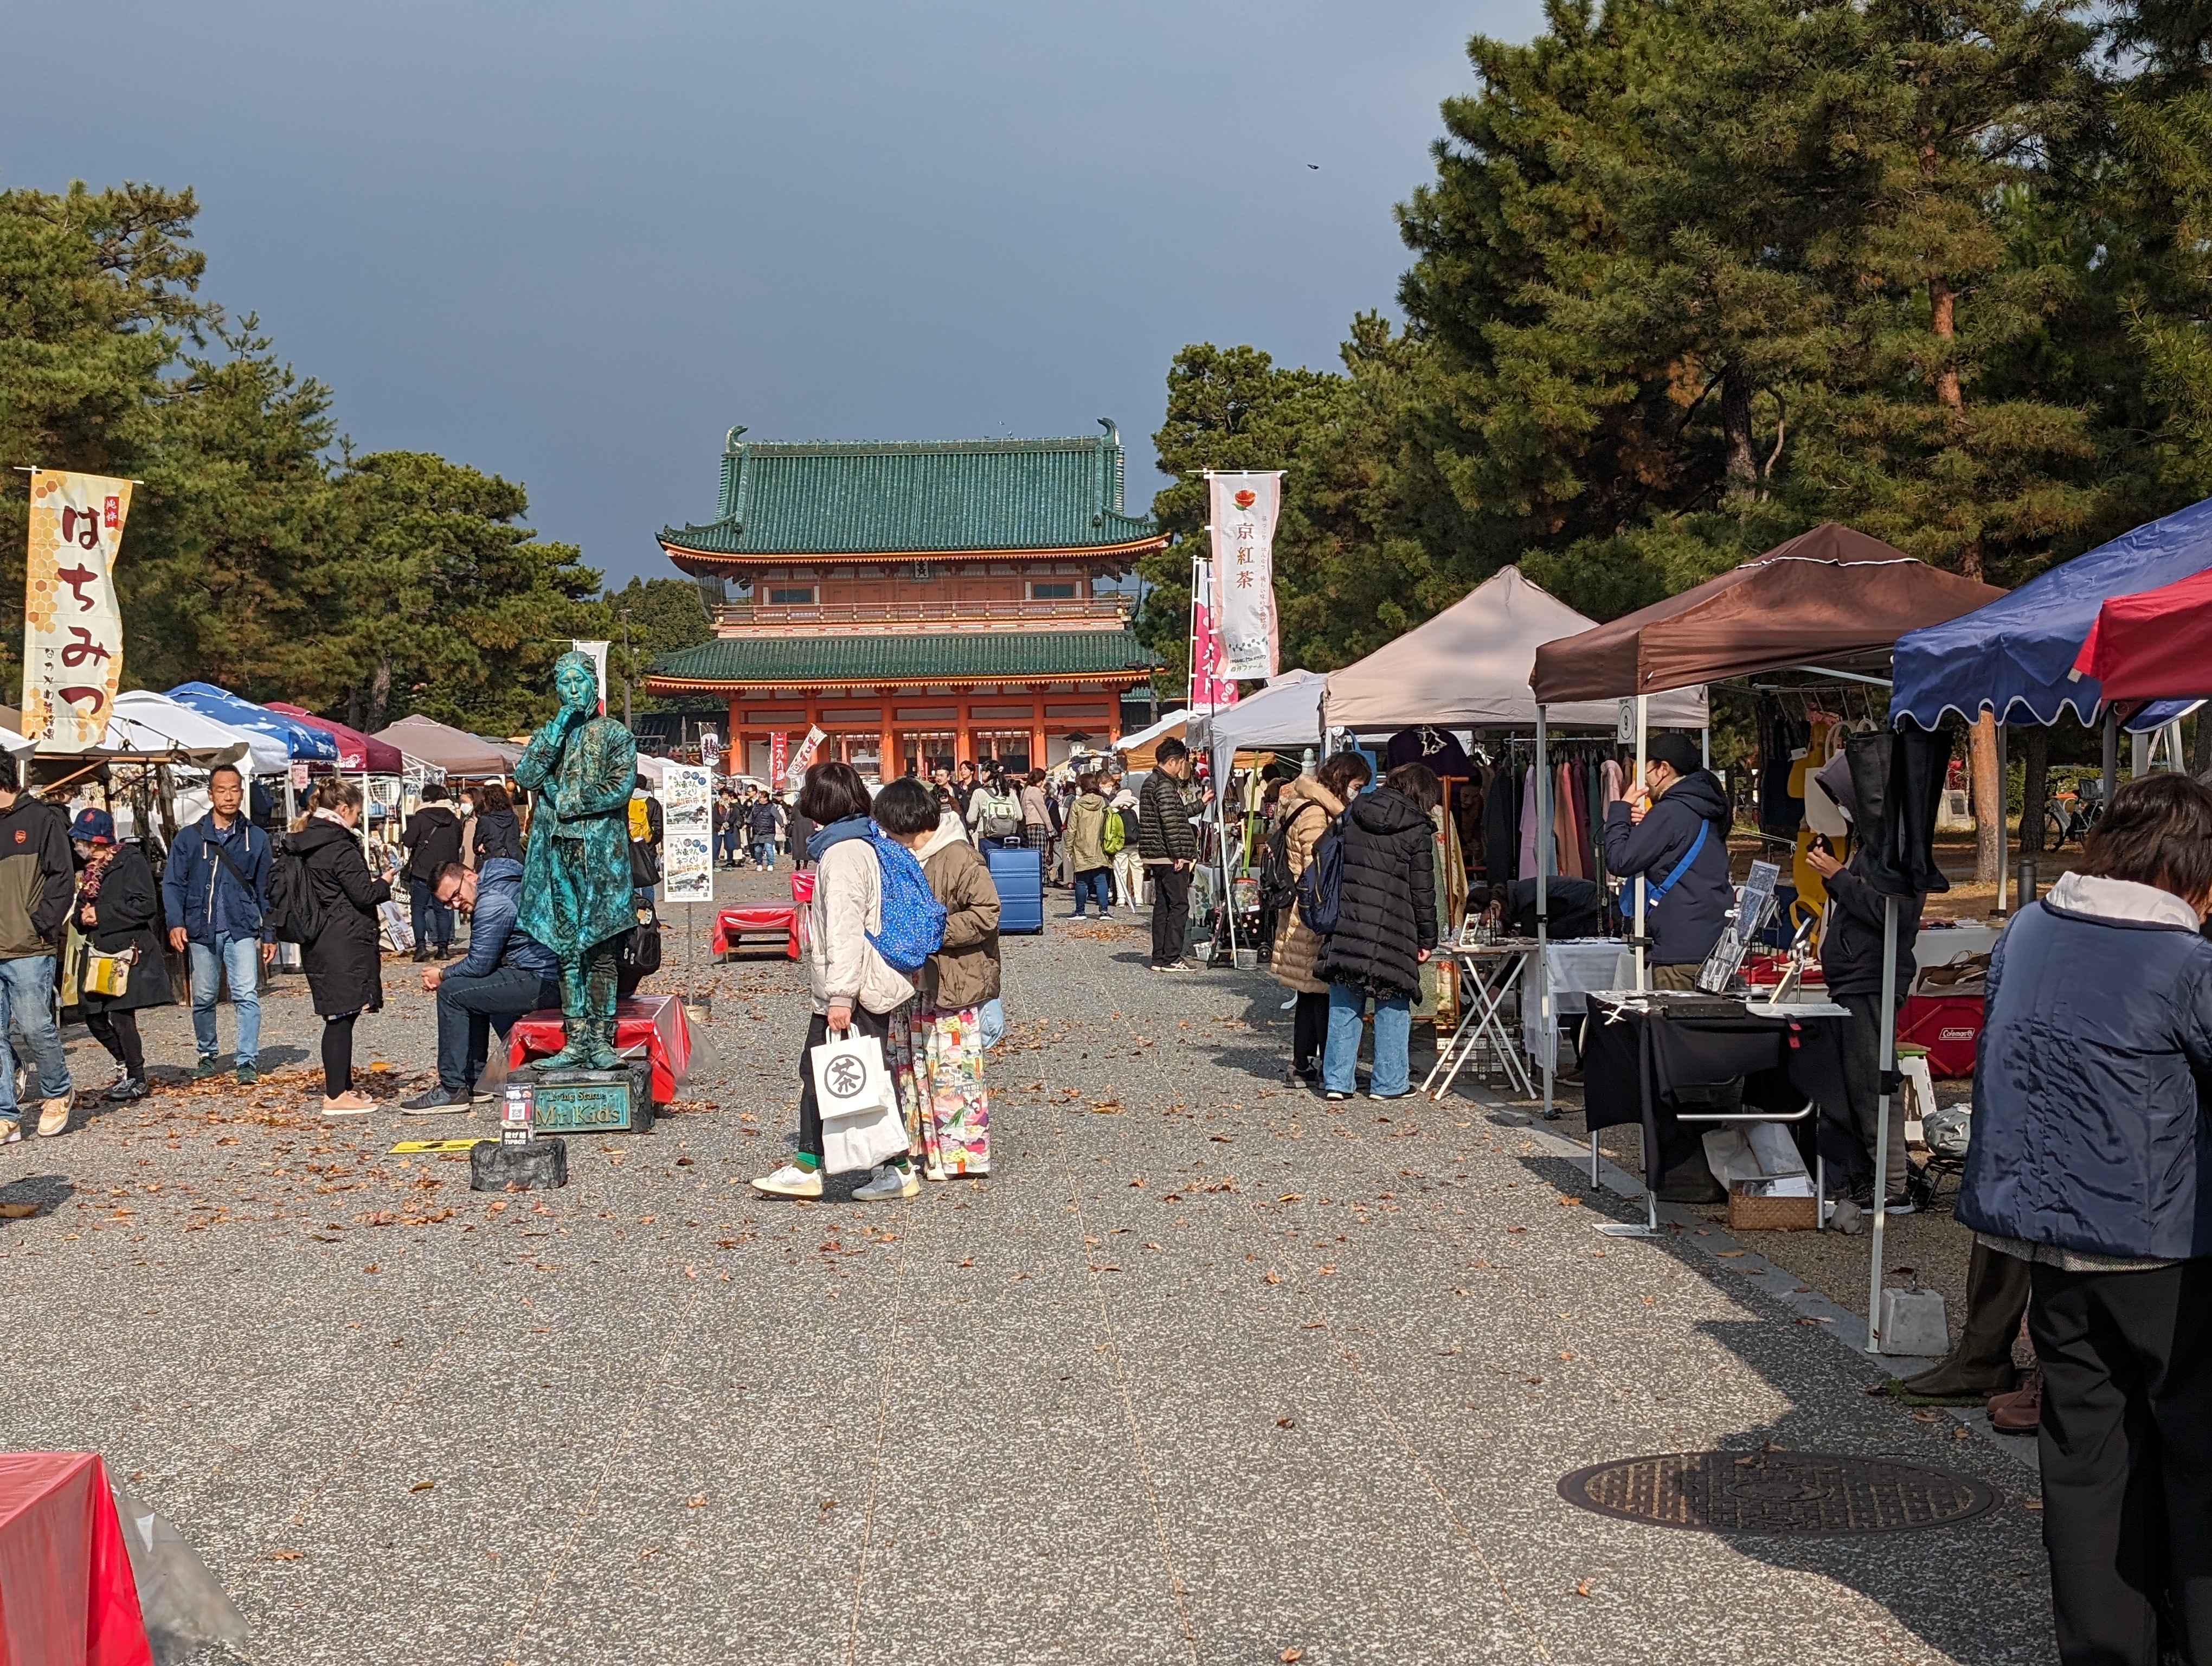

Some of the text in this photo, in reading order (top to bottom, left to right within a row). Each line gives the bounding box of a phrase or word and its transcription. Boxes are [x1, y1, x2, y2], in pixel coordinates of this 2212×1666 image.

[1236, 522, 1255, 589] 京紅茶
[58, 505, 112, 715] はちみつ
[832, 1058, 861, 1093] 茶
